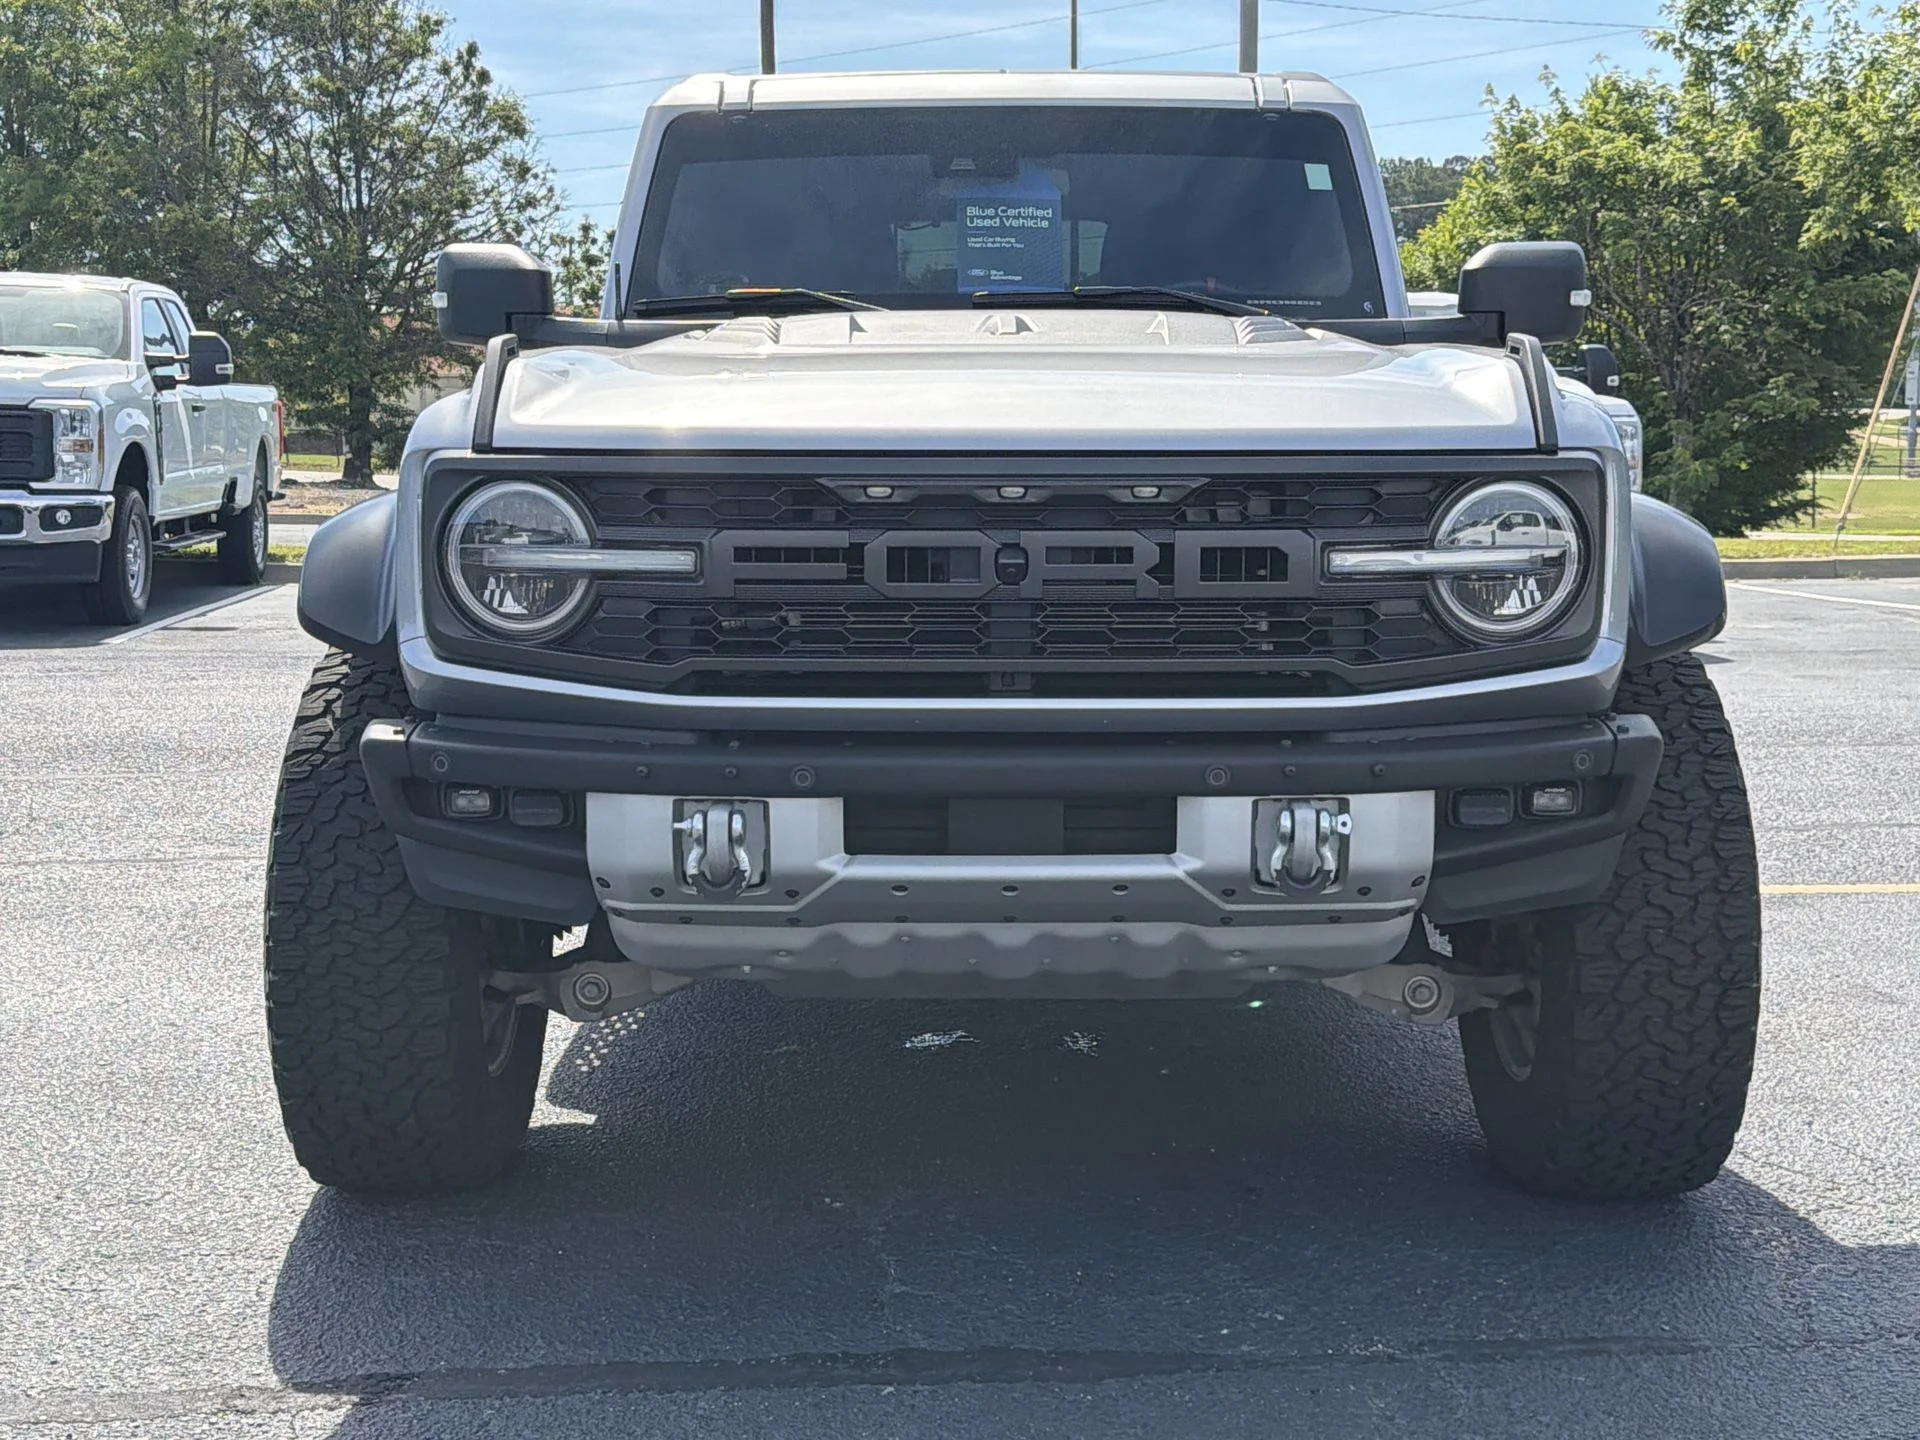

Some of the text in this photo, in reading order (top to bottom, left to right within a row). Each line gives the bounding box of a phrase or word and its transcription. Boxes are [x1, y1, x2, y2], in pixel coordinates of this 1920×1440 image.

[966, 206, 1053, 218] Blue Certified
[966, 217, 1049, 228] Used Vehicle
[705, 529, 1315, 599] FORD
